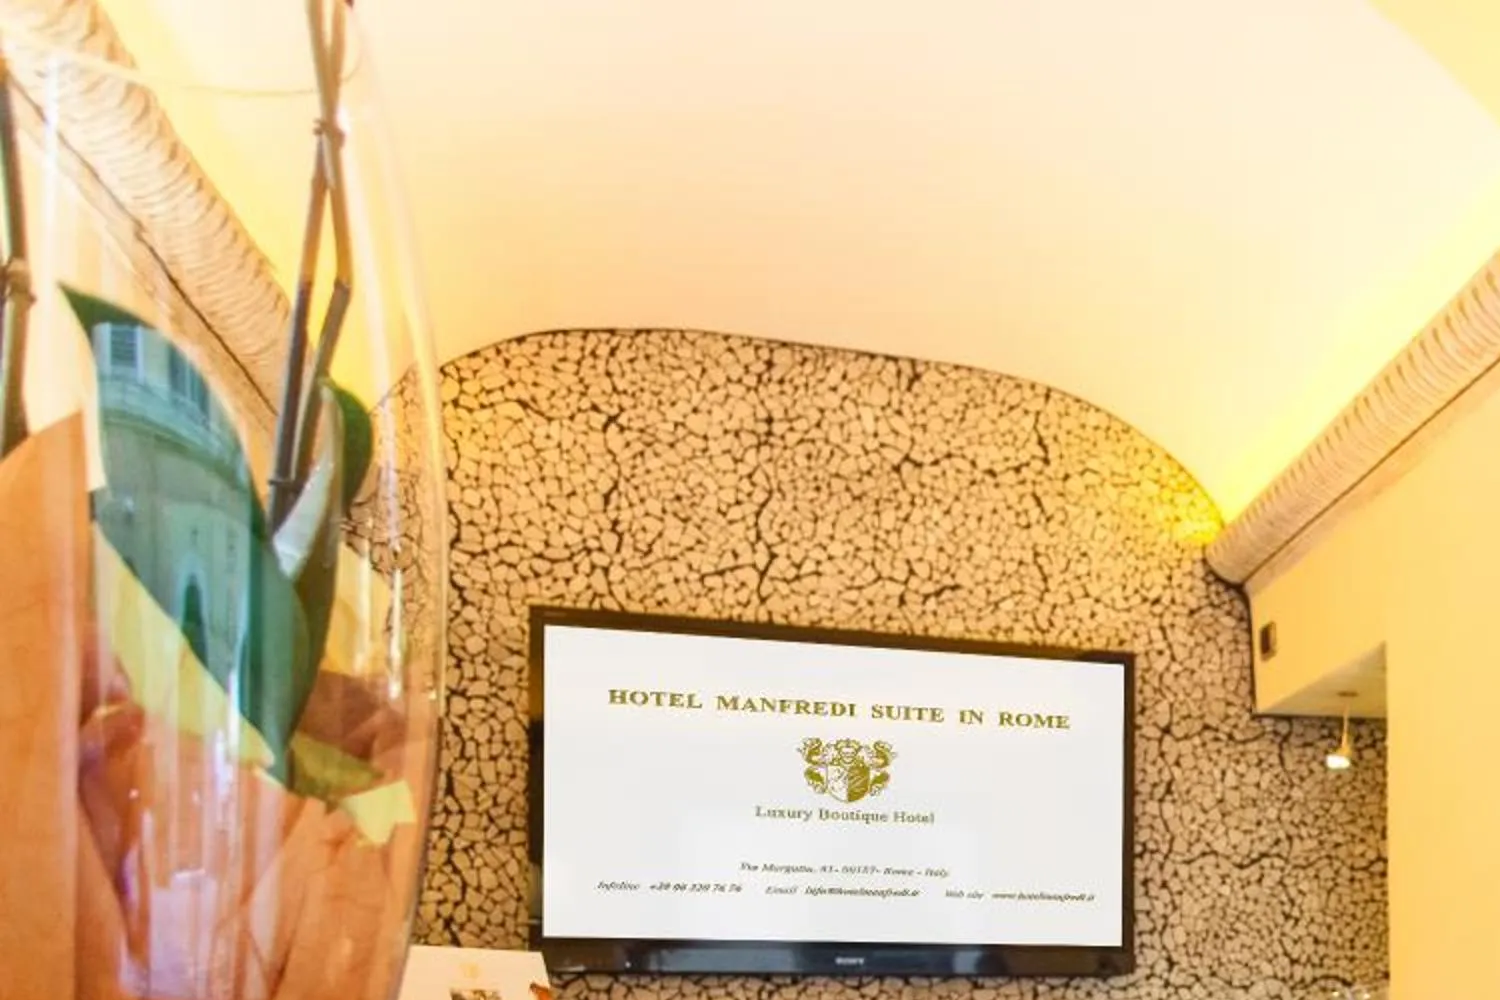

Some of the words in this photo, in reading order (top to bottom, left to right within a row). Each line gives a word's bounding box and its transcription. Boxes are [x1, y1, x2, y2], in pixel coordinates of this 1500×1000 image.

[608, 689, 703, 709] HOTEL
[714, 695, 856, 718] MANFREDI
[871, 703, 945, 723] SUITE
[959, 709, 984, 725] IN
[998, 711, 1071, 730] ROME
[755, 805, 813, 822] Luxury
[819, 807, 888, 825] Boutique
[893, 810, 935, 825] Hotel
